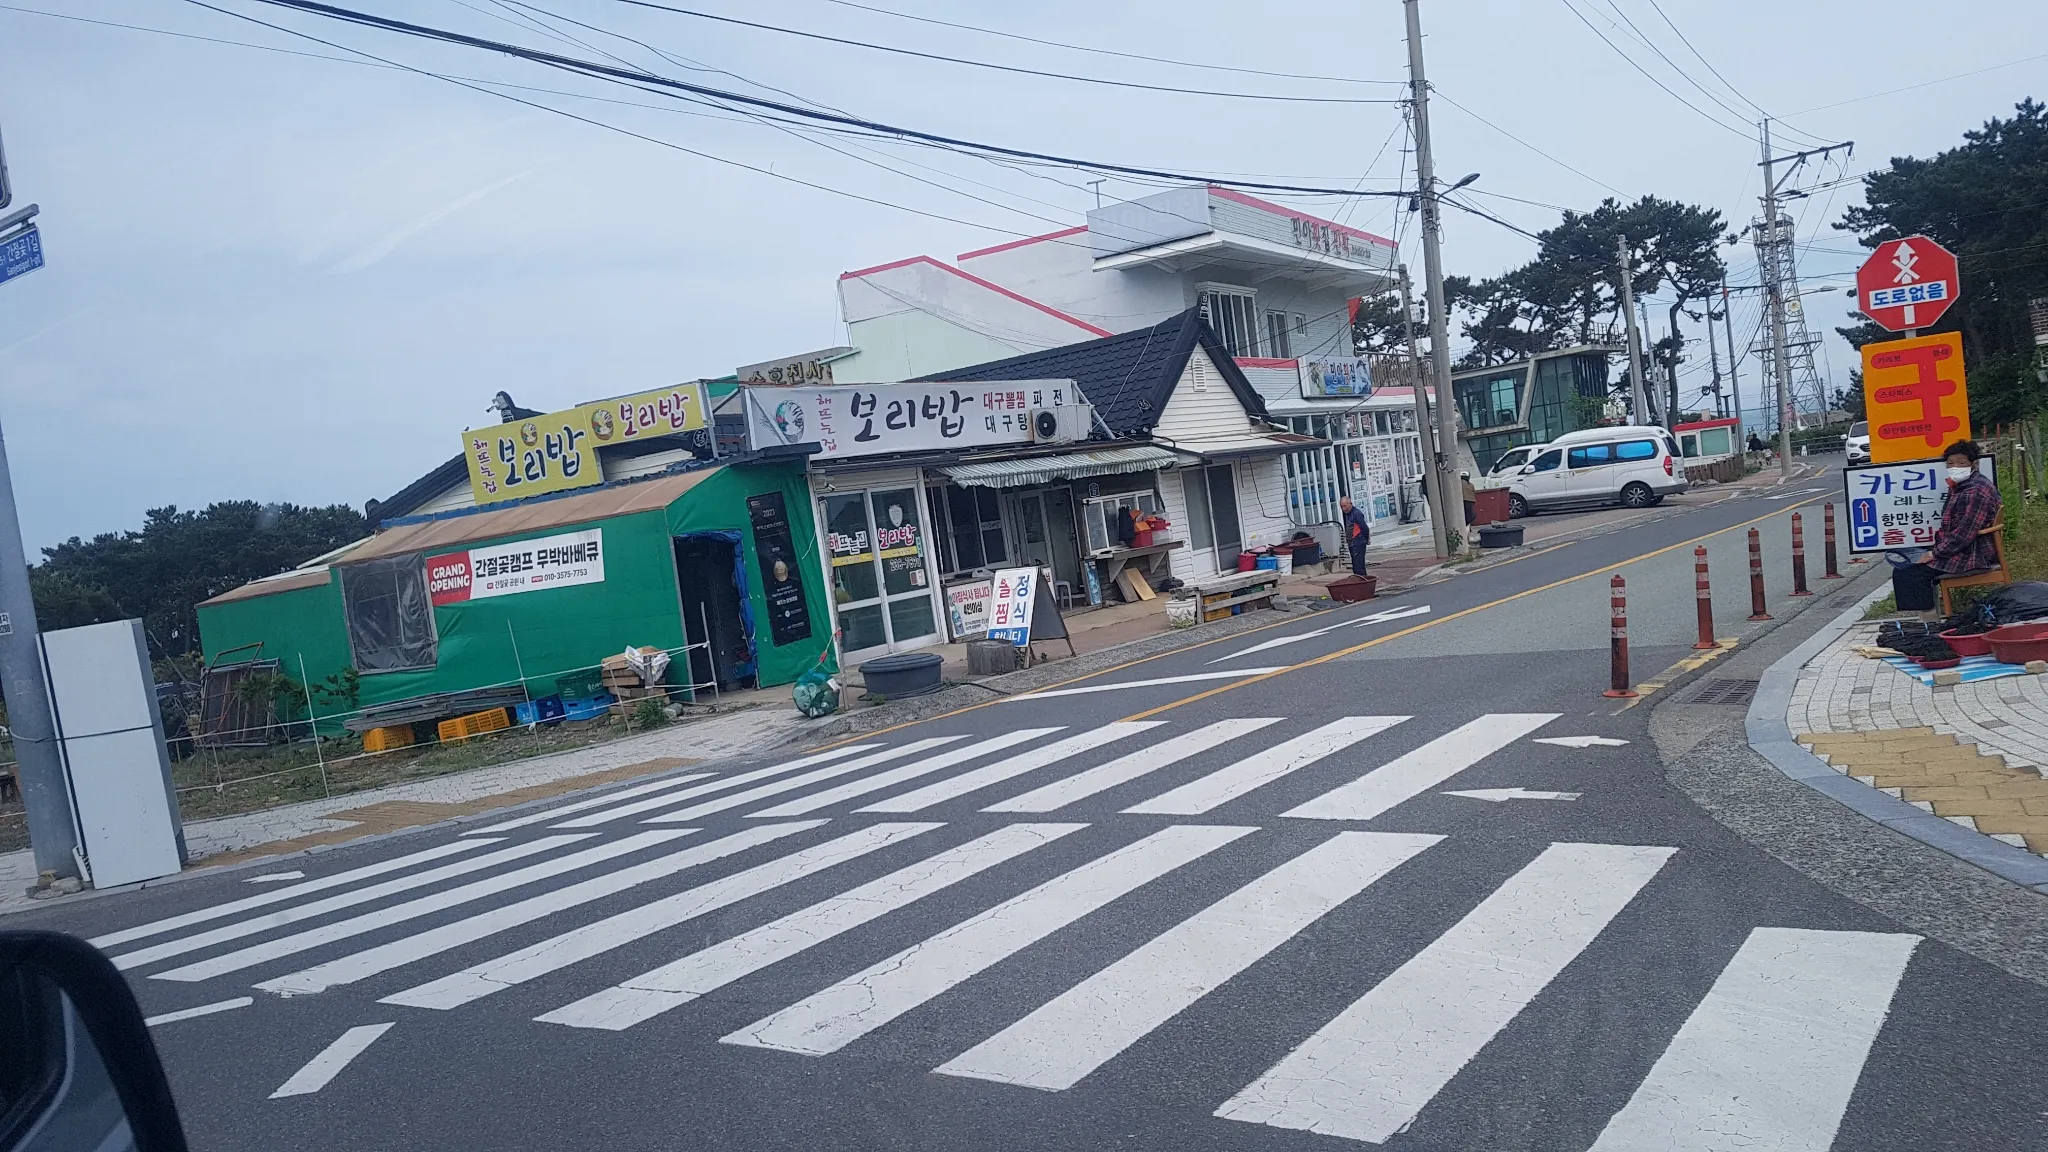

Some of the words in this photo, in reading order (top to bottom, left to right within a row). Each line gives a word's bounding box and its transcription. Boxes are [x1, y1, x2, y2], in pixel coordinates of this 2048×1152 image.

[1873, 282, 1944, 306] 도로없음
[983, 390, 1026, 410] 대구뽈찜
[620, 393, 688, 436] 보리밥
[851, 390, 974, 442] 보리밥
[498, 426, 584, 486] 보리밥
[1859, 469, 1936, 495] 카리
[877, 524, 916, 549] 보리밥
[1857, 525, 1876, 544] P
[1881, 526, 1934, 545] 출입
[432, 563, 466, 579] GRAND
[475, 551, 533, 578] 간절곶캠프
[537, 541, 599, 569] 무박바베큐
[430, 574, 471, 592] OPENING
